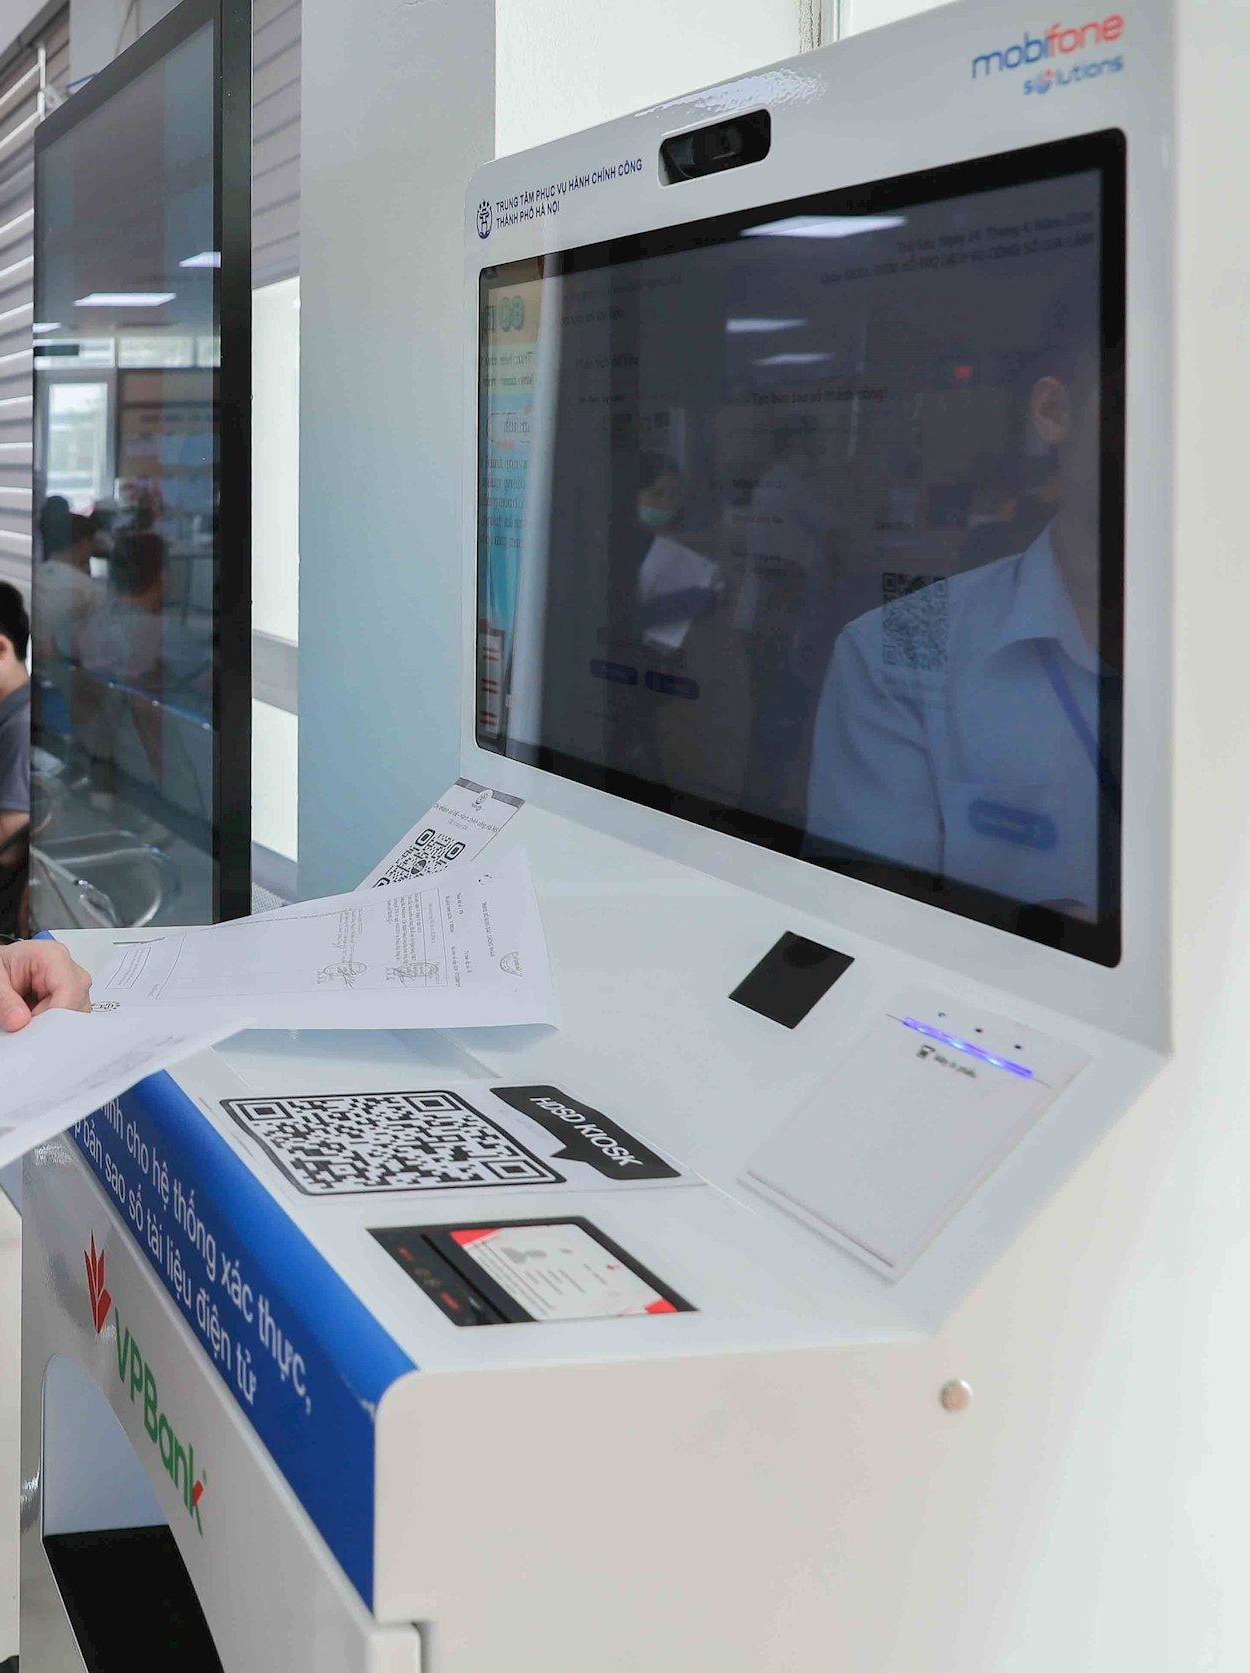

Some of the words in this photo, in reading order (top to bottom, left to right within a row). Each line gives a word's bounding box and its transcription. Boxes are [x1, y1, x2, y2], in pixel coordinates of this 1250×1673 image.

[972, 14, 1124, 79] mobifone
[496, 196, 518, 213] TRUNG
[520, 190, 534, 206] TÂM
[535, 185, 556, 202] PHỤC
[557, 181, 567, 195] VỤ
[568, 174, 590, 192] HÀNH
[591, 166, 616, 184] CHÍNH
[618, 158, 643, 176] CÔNG
[496, 212, 518, 228] THÀNH
[519, 206, 534, 222] PHỐ
[535, 205, 546, 218] HÀ
[547, 201, 560, 216] NỘI
[530, 1097, 586, 1123] HDSD
[574, 1124, 644, 1167] KIOSK
[105, 1152, 126, 1204] sao
[129, 1183, 144, 1232] số
[146, 1208, 163, 1264] tài
[166, 1235, 192, 1310] liệu
[197, 1287, 232, 1371] điện
[236, 1342, 257, 1405] tử
[126, 1120, 149, 1174] cho
[152, 1146, 170, 1211] hệ
[173, 1178, 216, 1282] thống
[220, 1252, 254, 1324] xác
[258, 1294, 312, 1417] thực,
[114, 1306, 206, 1538] VPBank
